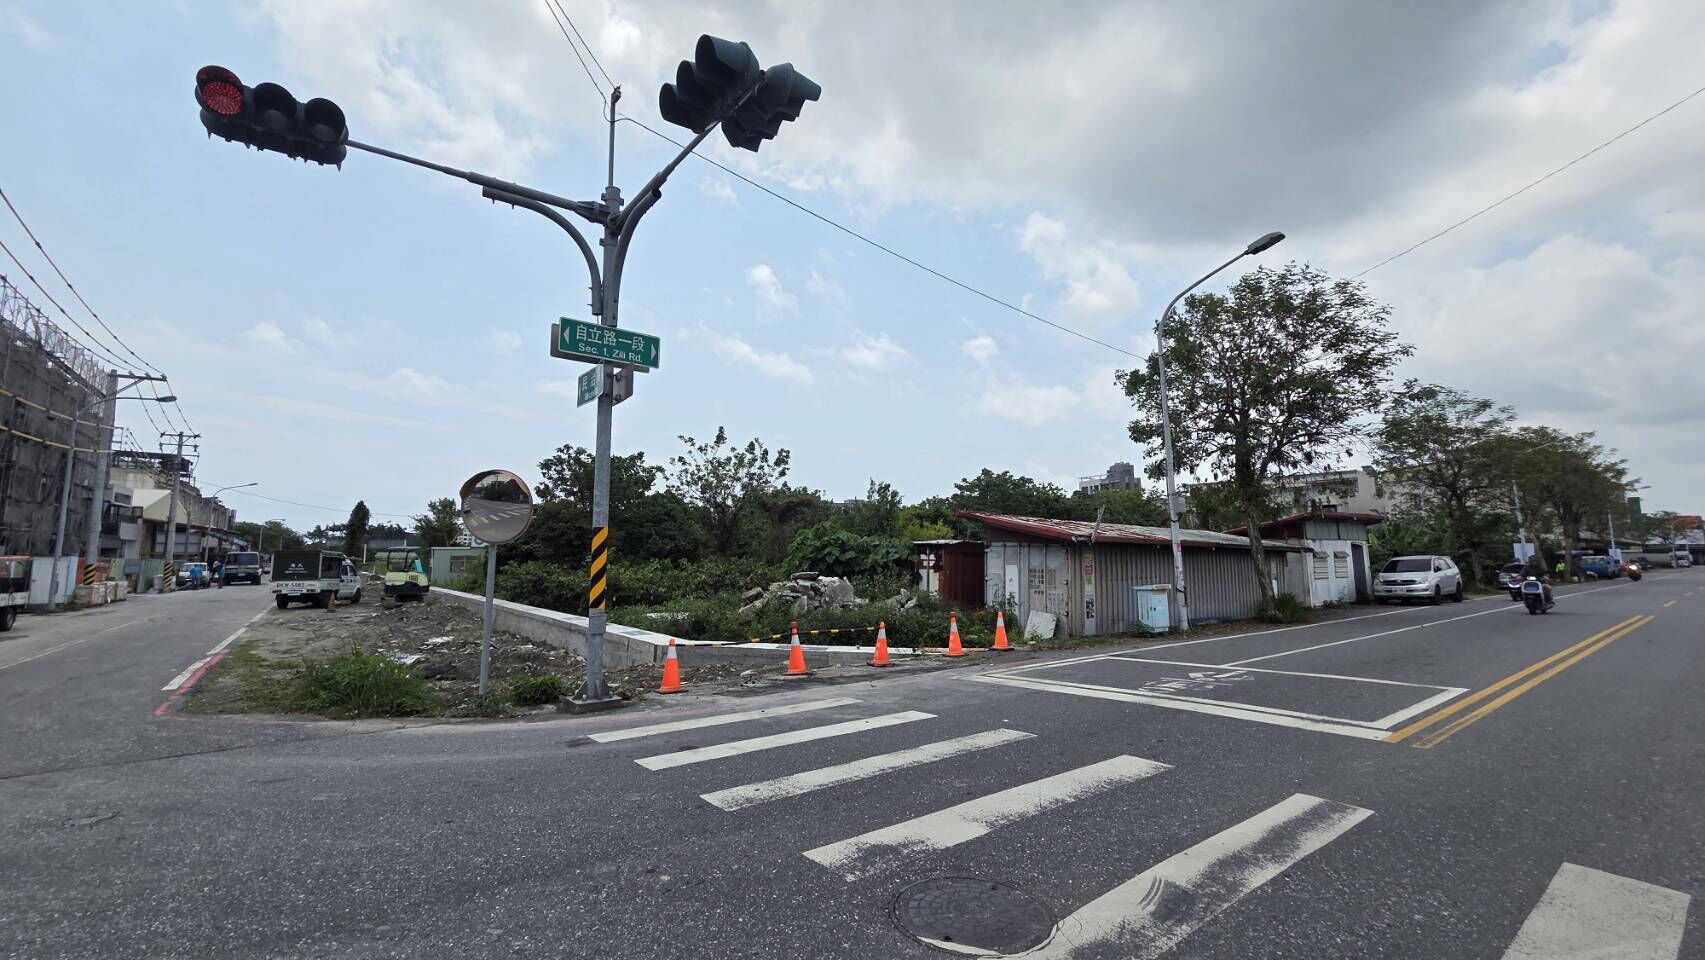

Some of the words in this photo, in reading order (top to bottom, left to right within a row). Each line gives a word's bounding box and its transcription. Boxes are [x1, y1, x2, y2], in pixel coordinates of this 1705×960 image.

[576, 324, 645, 351] 自立路一段
[578, 343, 599, 354] Sec.
[612, 349, 626, 359] Zili
[628, 352, 643, 363] Rd.
